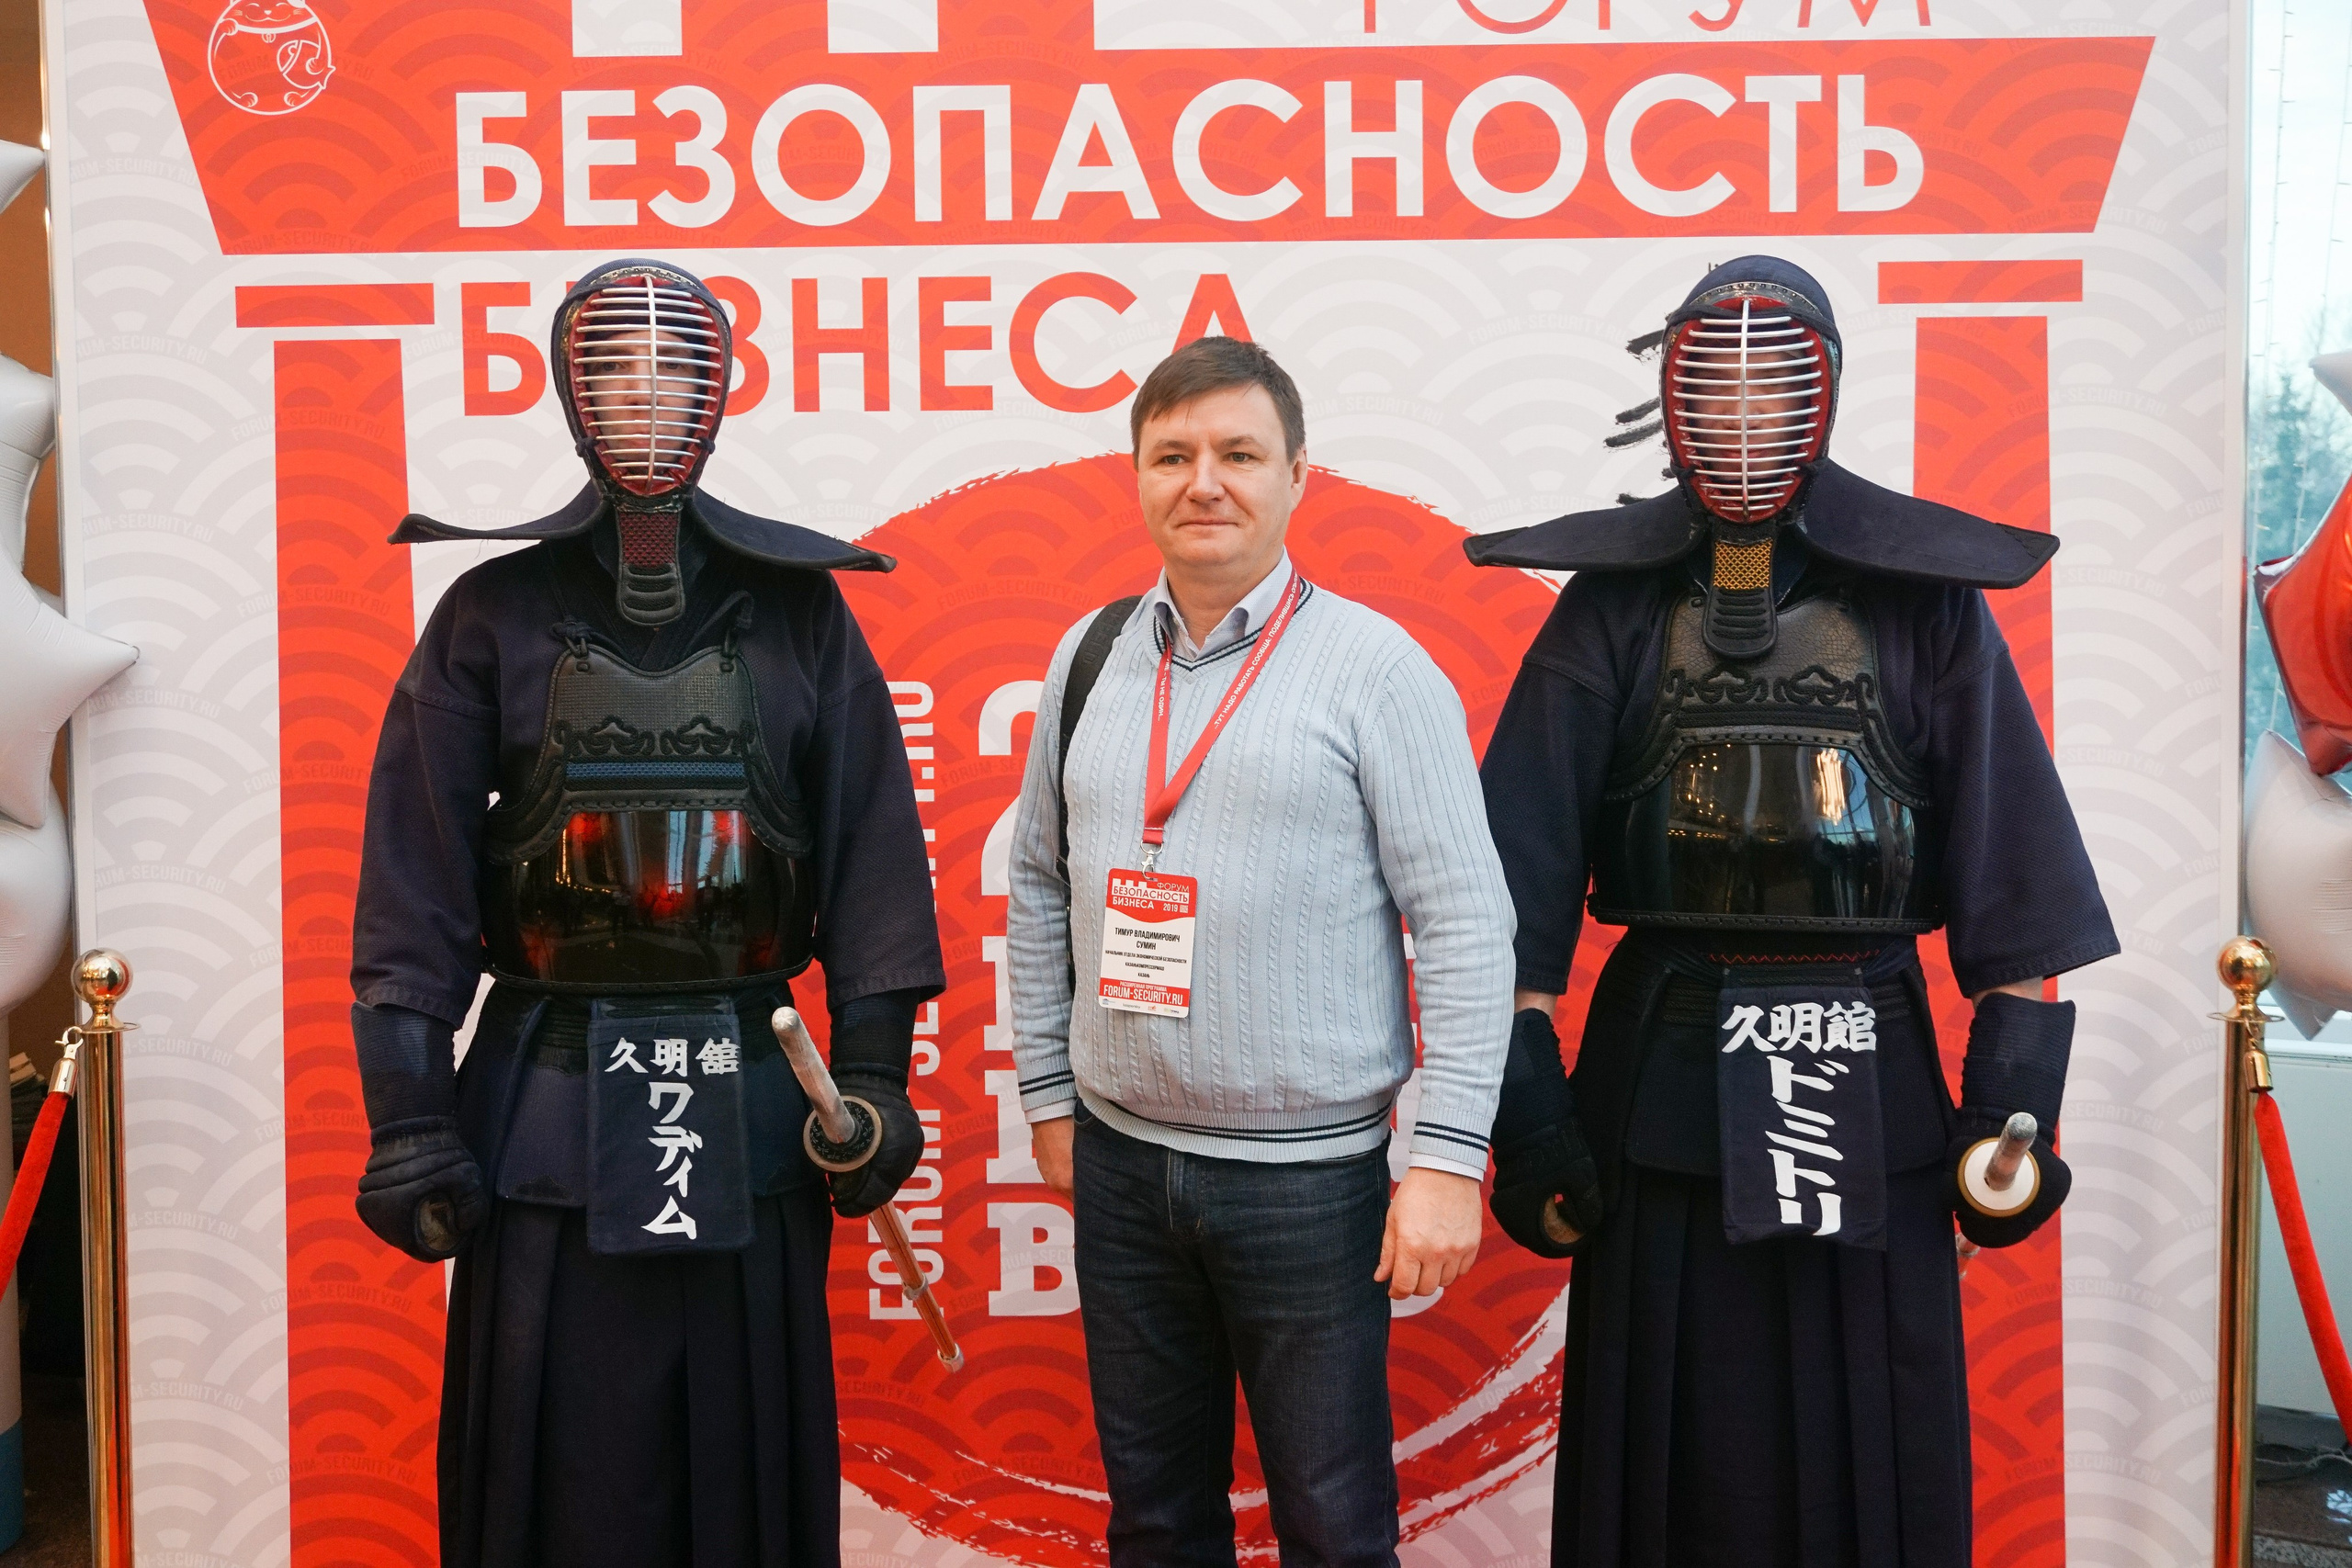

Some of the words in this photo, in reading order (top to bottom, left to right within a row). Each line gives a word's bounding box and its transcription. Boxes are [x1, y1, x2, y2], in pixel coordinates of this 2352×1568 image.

[456, 73, 1925, 228] БЕЗОПАСНОСТЬ
[70, 156, 197, 186] RUM-SECURITY.RU
[1838, 307, 1985, 339] ORUM-SECURITY.RU
[76, 333, 208, 365] UM-SECURITY.RU
[460, 271, 1254, 417] БЗНЕСА
[1306, 391, 1445, 425] RUM-SECURITY.RU
[83, 513, 214, 544] RUM-SECURITY.RU
[772, 502, 910, 532] RUM-SECURITY.RU
[1317, 570, 1445, 603] UM-SECURITY.RU
[1222, 694, 1237, 714] НАДО
[1234, 666, 1255, 694] РАБОТАТЬ
[1251, 637, 1272, 666] СООБЩА:
[1269, 592, 1295, 637] ПОДЕЛИВШИСЬ
[89, 687, 220, 719] RUM-SECURITY.RU
[243, 760, 369, 794] FORUM-SECURIT
[2056, 746, 2165, 777] -SECURITY.RU
[96, 864, 227, 895] RUM-SECURITY.RU
[1114, 886, 1188, 903] БЕЗОПАСНОСТЬ
[1157, 882, 1190, 892] ФОРУМ
[1113, 896, 1155, 909] БИЗНЕСА
[1163, 903, 1178, 913] 2019
[1114, 927, 1134, 937] ТИМУР
[1134, 930, 1181, 942] ВЛАДИМИРОВИЧ
[1136, 941, 1157, 950] СУМИН
[1103, 985, 1183, 1005] FORUM-SECURITY.RU
[125, 1038, 233, 1066] M-SECURITY.RU
[2065, 1102, 2165, 1134] SECURITY.RU
[129, 1211, 240, 1240] M-SECURITY.RU
[2005, 1276, 2163, 1311] FORUMSECURITY.RU
[130, 1382, 244, 1411] M-SECURITY.RU
[2005, 1451, 2161, 1484] FORUMSECURITY.RU
